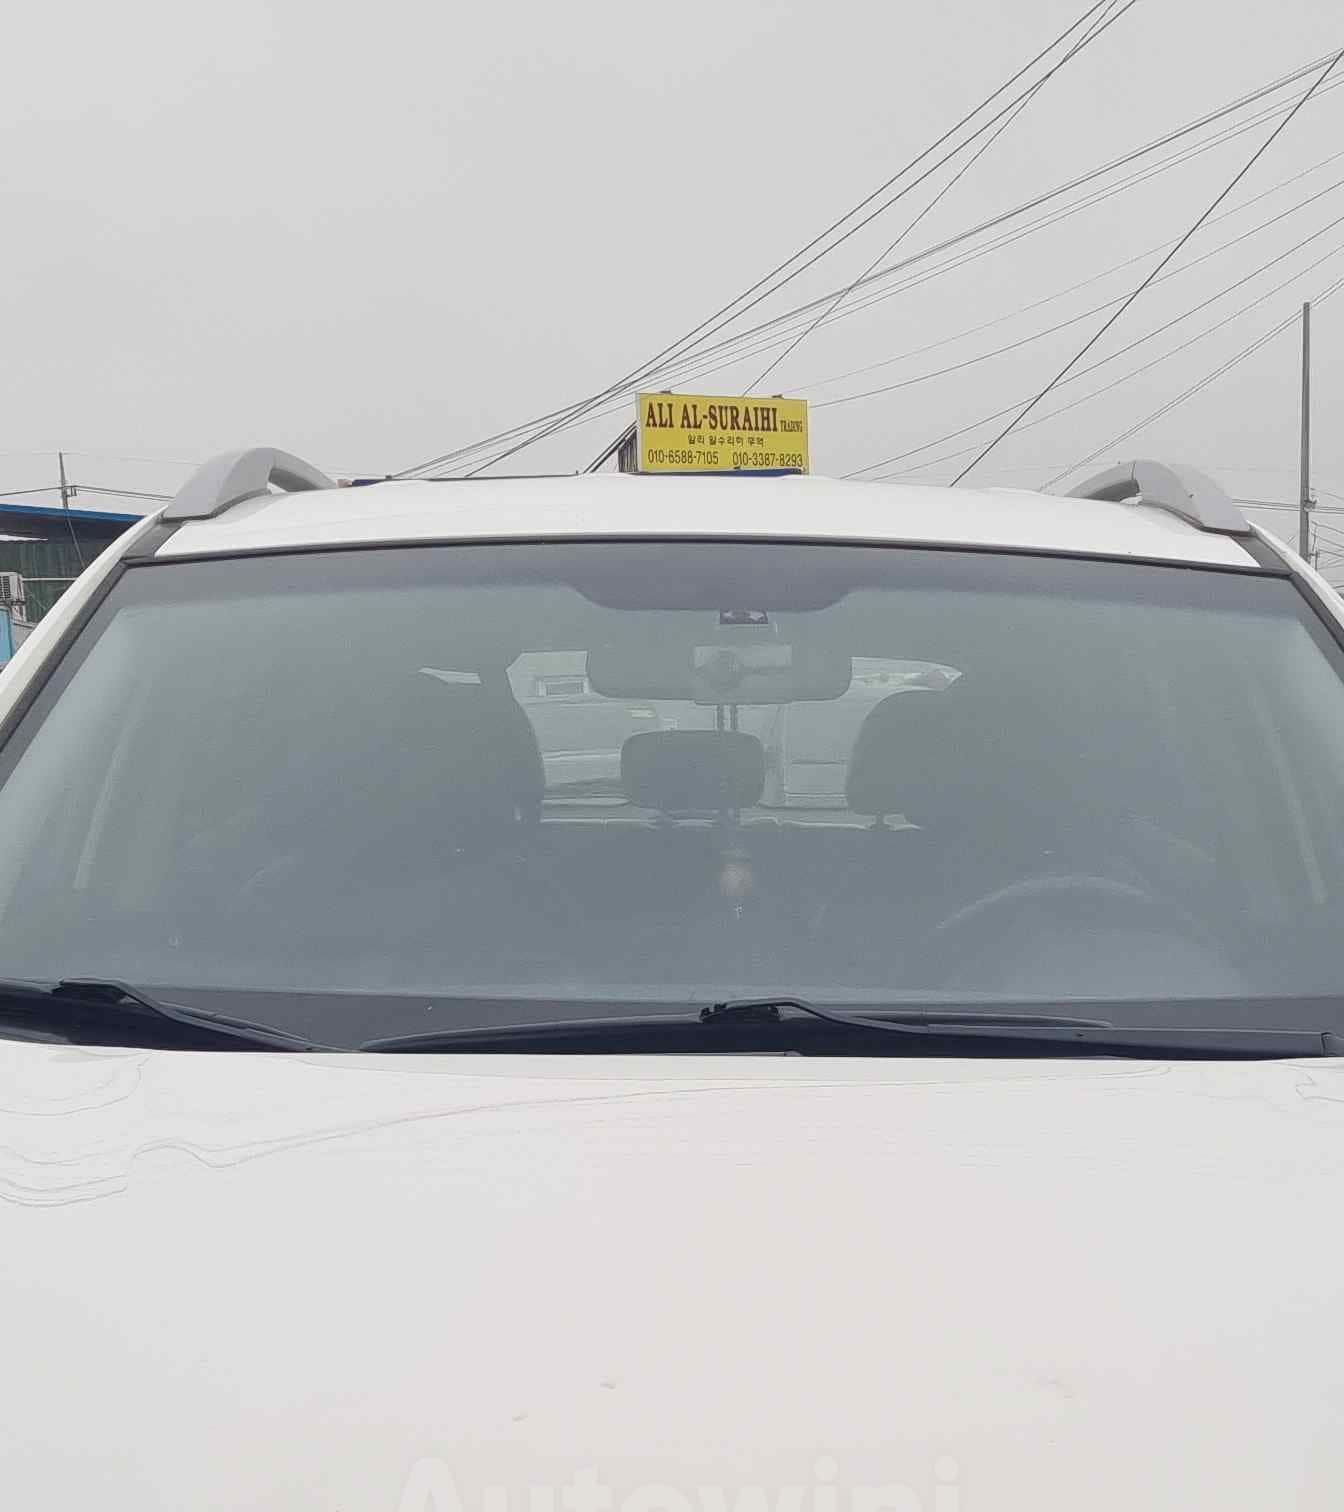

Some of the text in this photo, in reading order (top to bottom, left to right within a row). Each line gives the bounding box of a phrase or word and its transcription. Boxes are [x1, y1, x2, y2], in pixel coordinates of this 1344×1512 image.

[645, 402, 674, 428] ALI
[680, 403, 778, 432] AL-SURAIHI
[647, 449, 719, 465] 010-6588-7105
